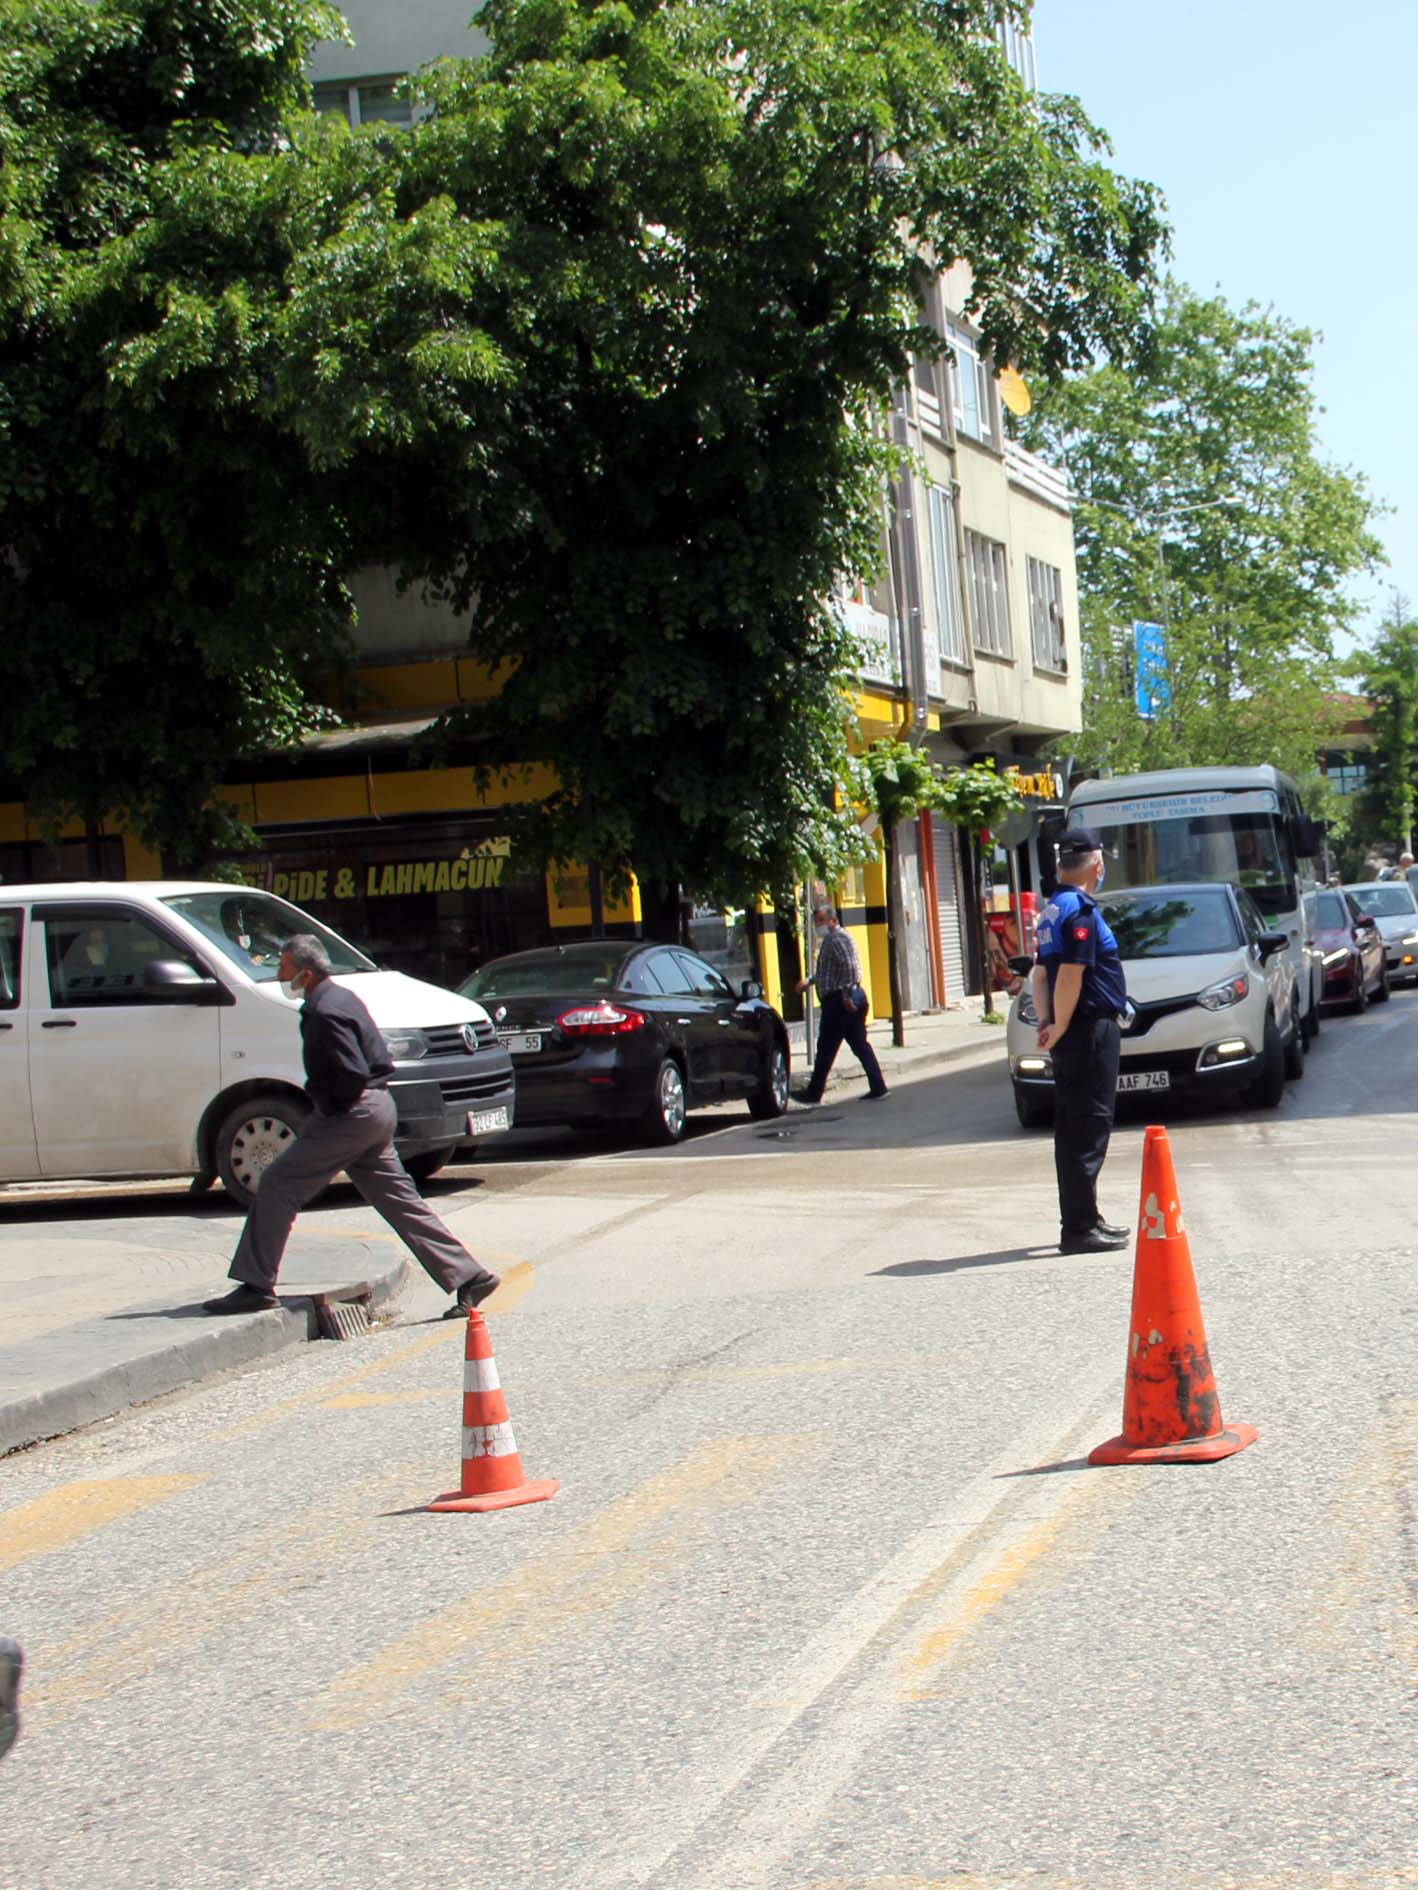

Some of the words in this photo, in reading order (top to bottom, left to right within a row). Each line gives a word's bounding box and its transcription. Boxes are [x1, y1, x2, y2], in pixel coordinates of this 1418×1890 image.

[334, 867, 355, 898] &
[366, 857, 504, 897] LAHMACUN
[525, 1036, 540, 1049] 55
[1118, 1076, 1140, 1090] AAF
[1145, 1073, 1167, 1087] 746
